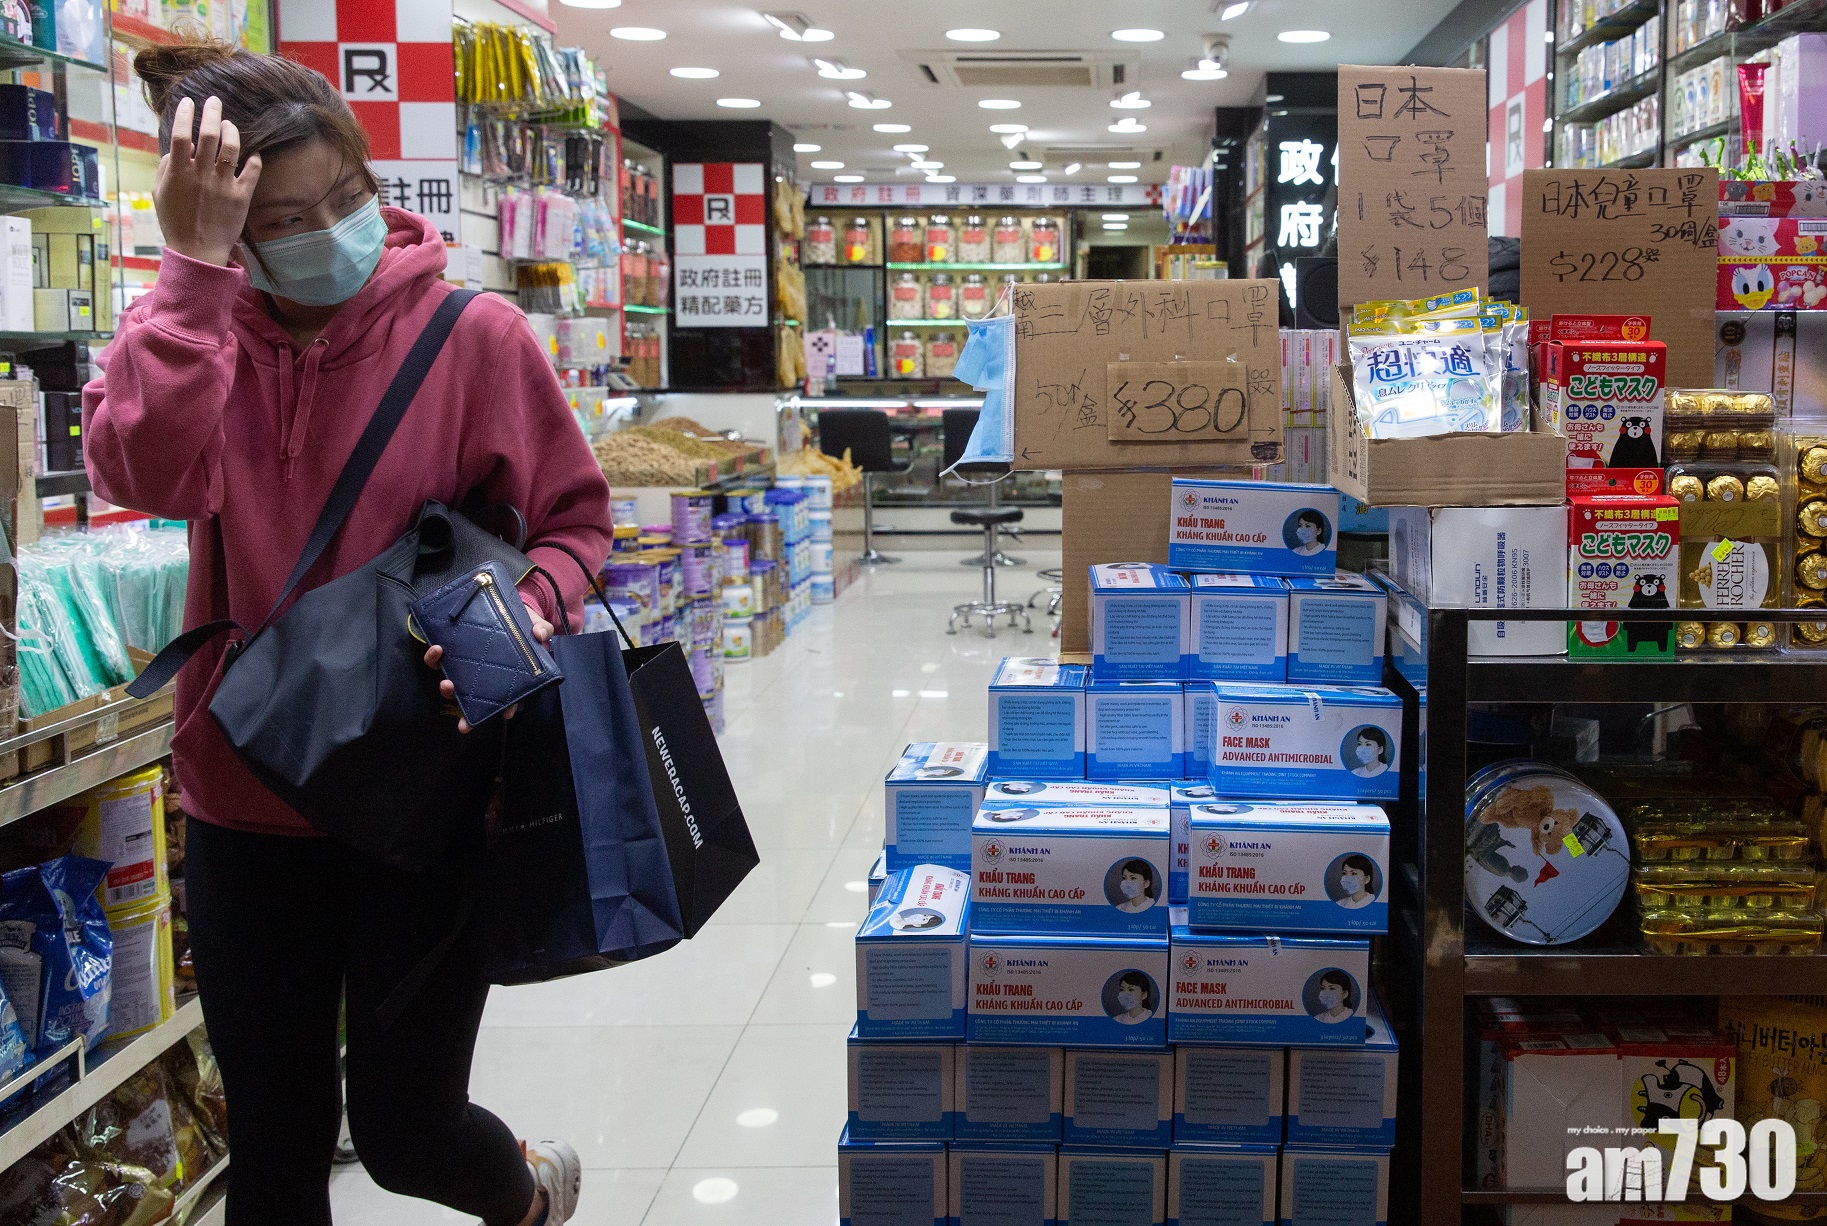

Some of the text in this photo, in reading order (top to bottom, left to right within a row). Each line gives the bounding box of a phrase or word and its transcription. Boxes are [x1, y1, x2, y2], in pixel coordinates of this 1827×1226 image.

[1355, 76, 1450, 119] 日本
[1362, 131, 1454, 184] 口罩
[1542, 174, 1704, 219] 日本兒童口罩
[1361, 245, 1469, 282] $148
[1550, 247, 1644, 282] $228
[679, 269, 763, 288] 政府註冊
[1779, 269, 1816, 280] POPCAN
[679, 295, 764, 316] 精配藥方
[1034, 286, 1273, 347] 三層外科口罩
[1627, 327, 1640, 336] 30
[1569, 375, 1657, 398] こどもマスク
[1113, 380, 1246, 433] $380
[1566, 423, 1604, 431] お母さんも
[1568, 442, 1603, 451] 使えます!
[1640, 481, 1652, 489] 30
[1178, 514, 1225, 529] KHẨU TRANG
[1177, 530, 1266, 543] KHÁNG KHUẨN CAO CẤP
[1581, 533, 1671, 556] こどもマスク
[1522, 549, 1530, 567] 3007
[1716, 552, 1730, 606] FERRER
[1731, 544, 1744, 606] ROCHER
[1496, 531, 1506, 638] 自吸滤式防颗粒物呼吸器
[1579, 581, 1618, 590] お母さんも
[1582, 592, 1606, 600] 一緒に
[1223, 736, 1270, 748] FACE MASK
[1222, 752, 1333, 764] ADVANCED ANTIMICROBIAL
[652, 725, 704, 850] NEWERACAP.COM
[529, 813, 563, 828] HILFIGER
[979, 868, 1035, 884] KHẨU TRANG
[1199, 862, 1255, 879] KHẨU TRANG
[979, 886, 1085, 900] KHÁNG KHUẨN CAO CẤP
[1199, 881, 1305, 895] KHÁNG KHUẨN CAO CẤP
[977, 980, 1032, 996] KHẨU TRANG
[1176, 982, 1227, 994] FACE MASK
[976, 998, 1082, 1011] KHÁNG KHUẨN CAO CẤP
[1176, 998, 1294, 1010] ADVANCED ANTIMICROBIAL
